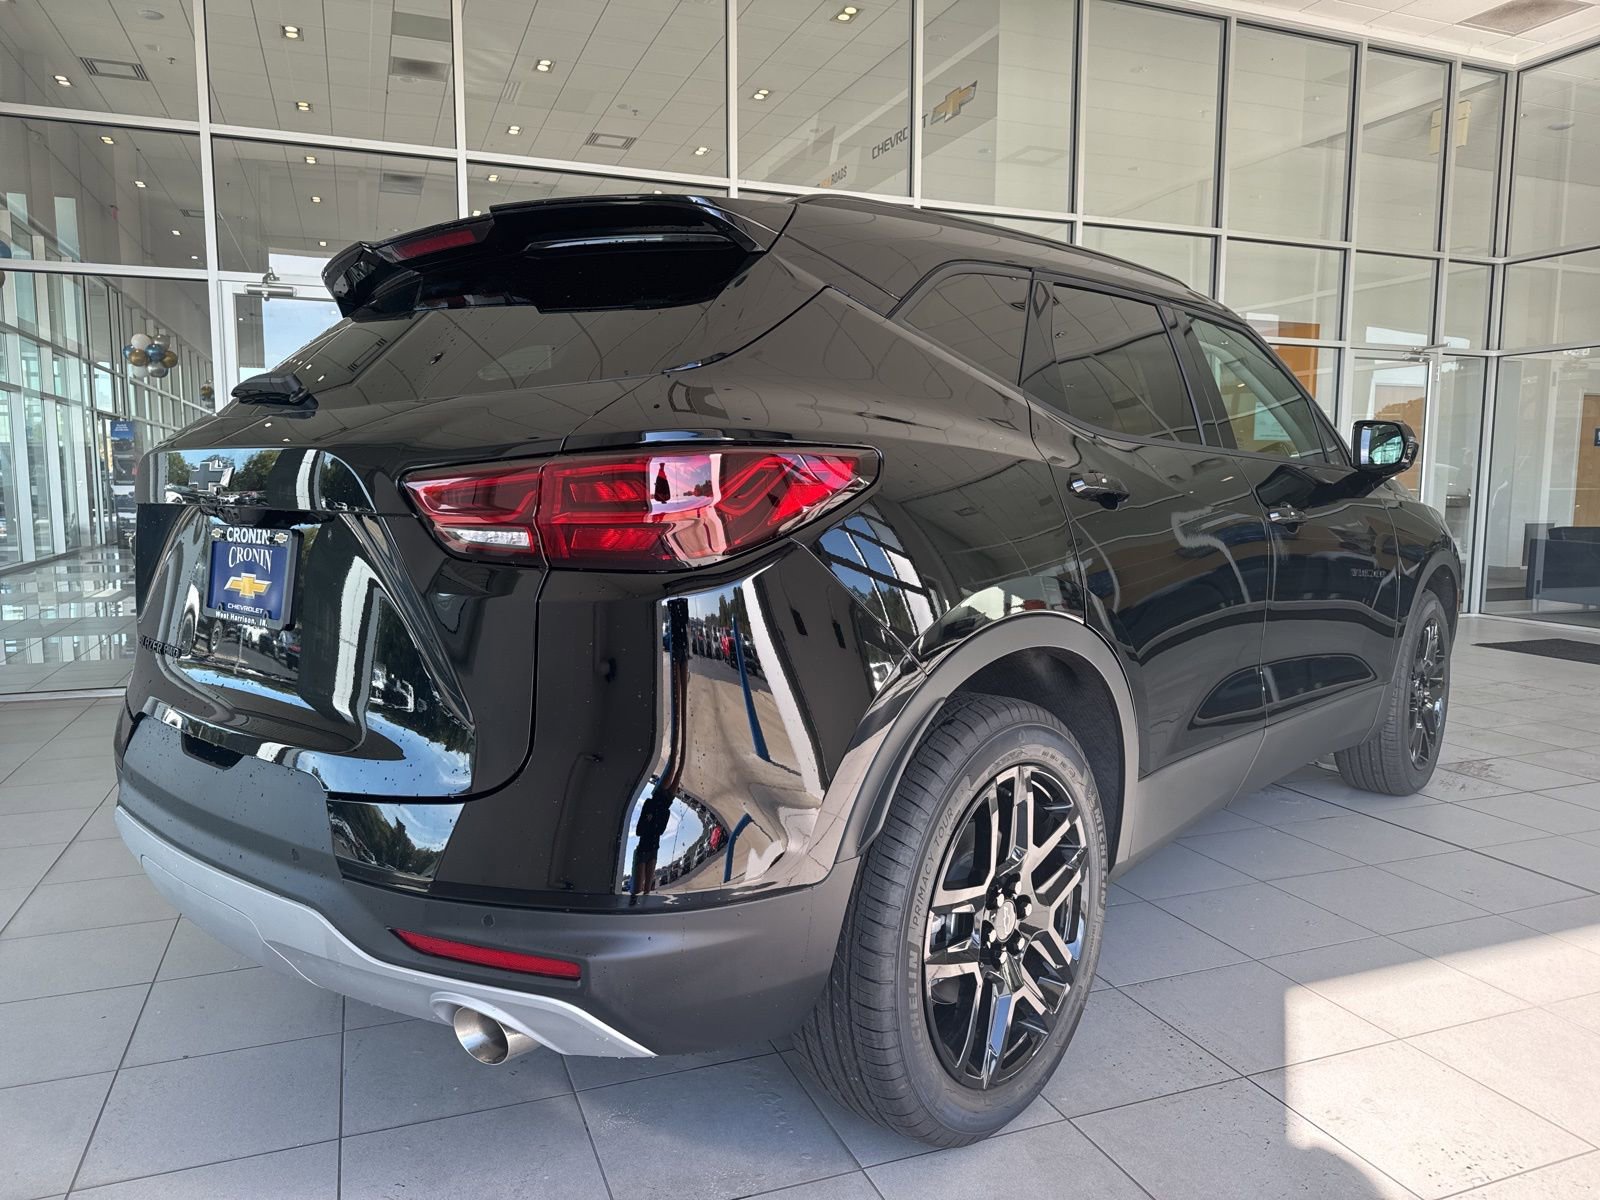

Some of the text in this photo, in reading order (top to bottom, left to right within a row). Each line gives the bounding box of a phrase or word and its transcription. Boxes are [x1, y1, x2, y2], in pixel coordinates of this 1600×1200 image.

[871, 113, 929, 160] CHEVROT
[226, 527, 271, 545] CRONIN
[228, 546, 273, 574] CRONIN
[215, 610, 229, 619] West
[227, 602, 264, 614] CHEVROLET
[912, 807, 954, 927] PRIMACY TOUR
[1094, 807, 1106, 906] MICHELIN
[907, 949, 922, 1046] CHELIN
